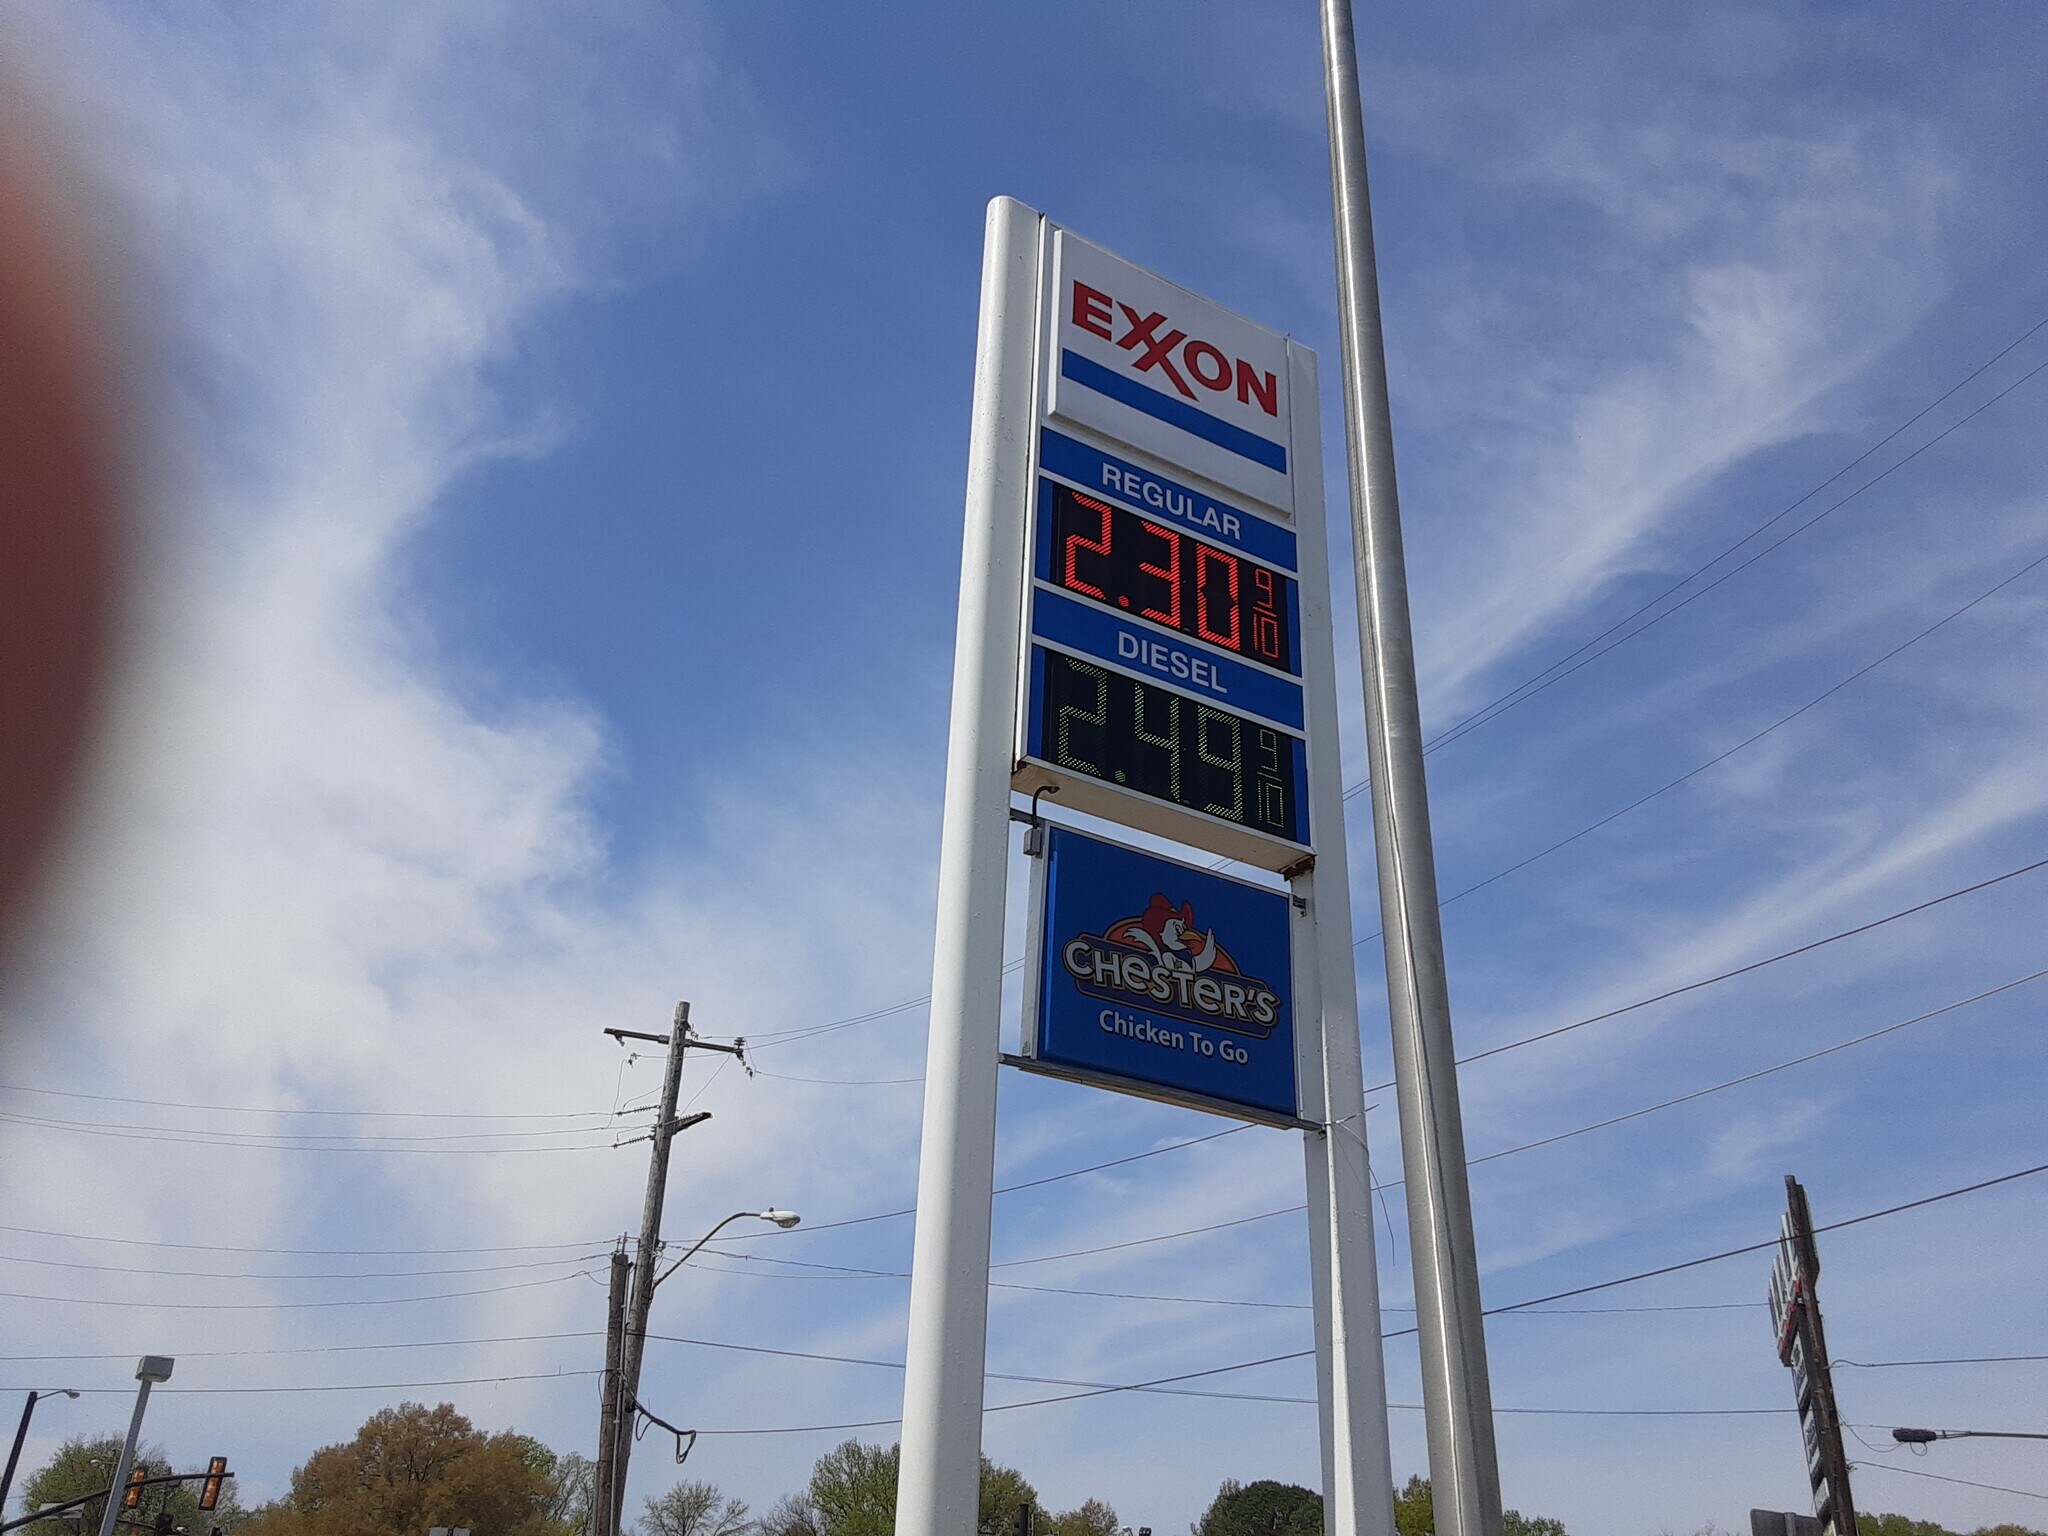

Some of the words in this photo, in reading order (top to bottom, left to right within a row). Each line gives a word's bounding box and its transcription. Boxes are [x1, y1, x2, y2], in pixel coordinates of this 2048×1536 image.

[1072, 280, 1277, 417] EXXON
[1102, 462, 1241, 540] REGULAR
[1065, 491, 1240, 650] 2.30
[1118, 630, 1228, 694] DIESEL
[1100, 1009, 1184, 1050] Chicken
[1188, 1031, 1214, 1057] To
[1219, 1039, 1249, 1065] Go
